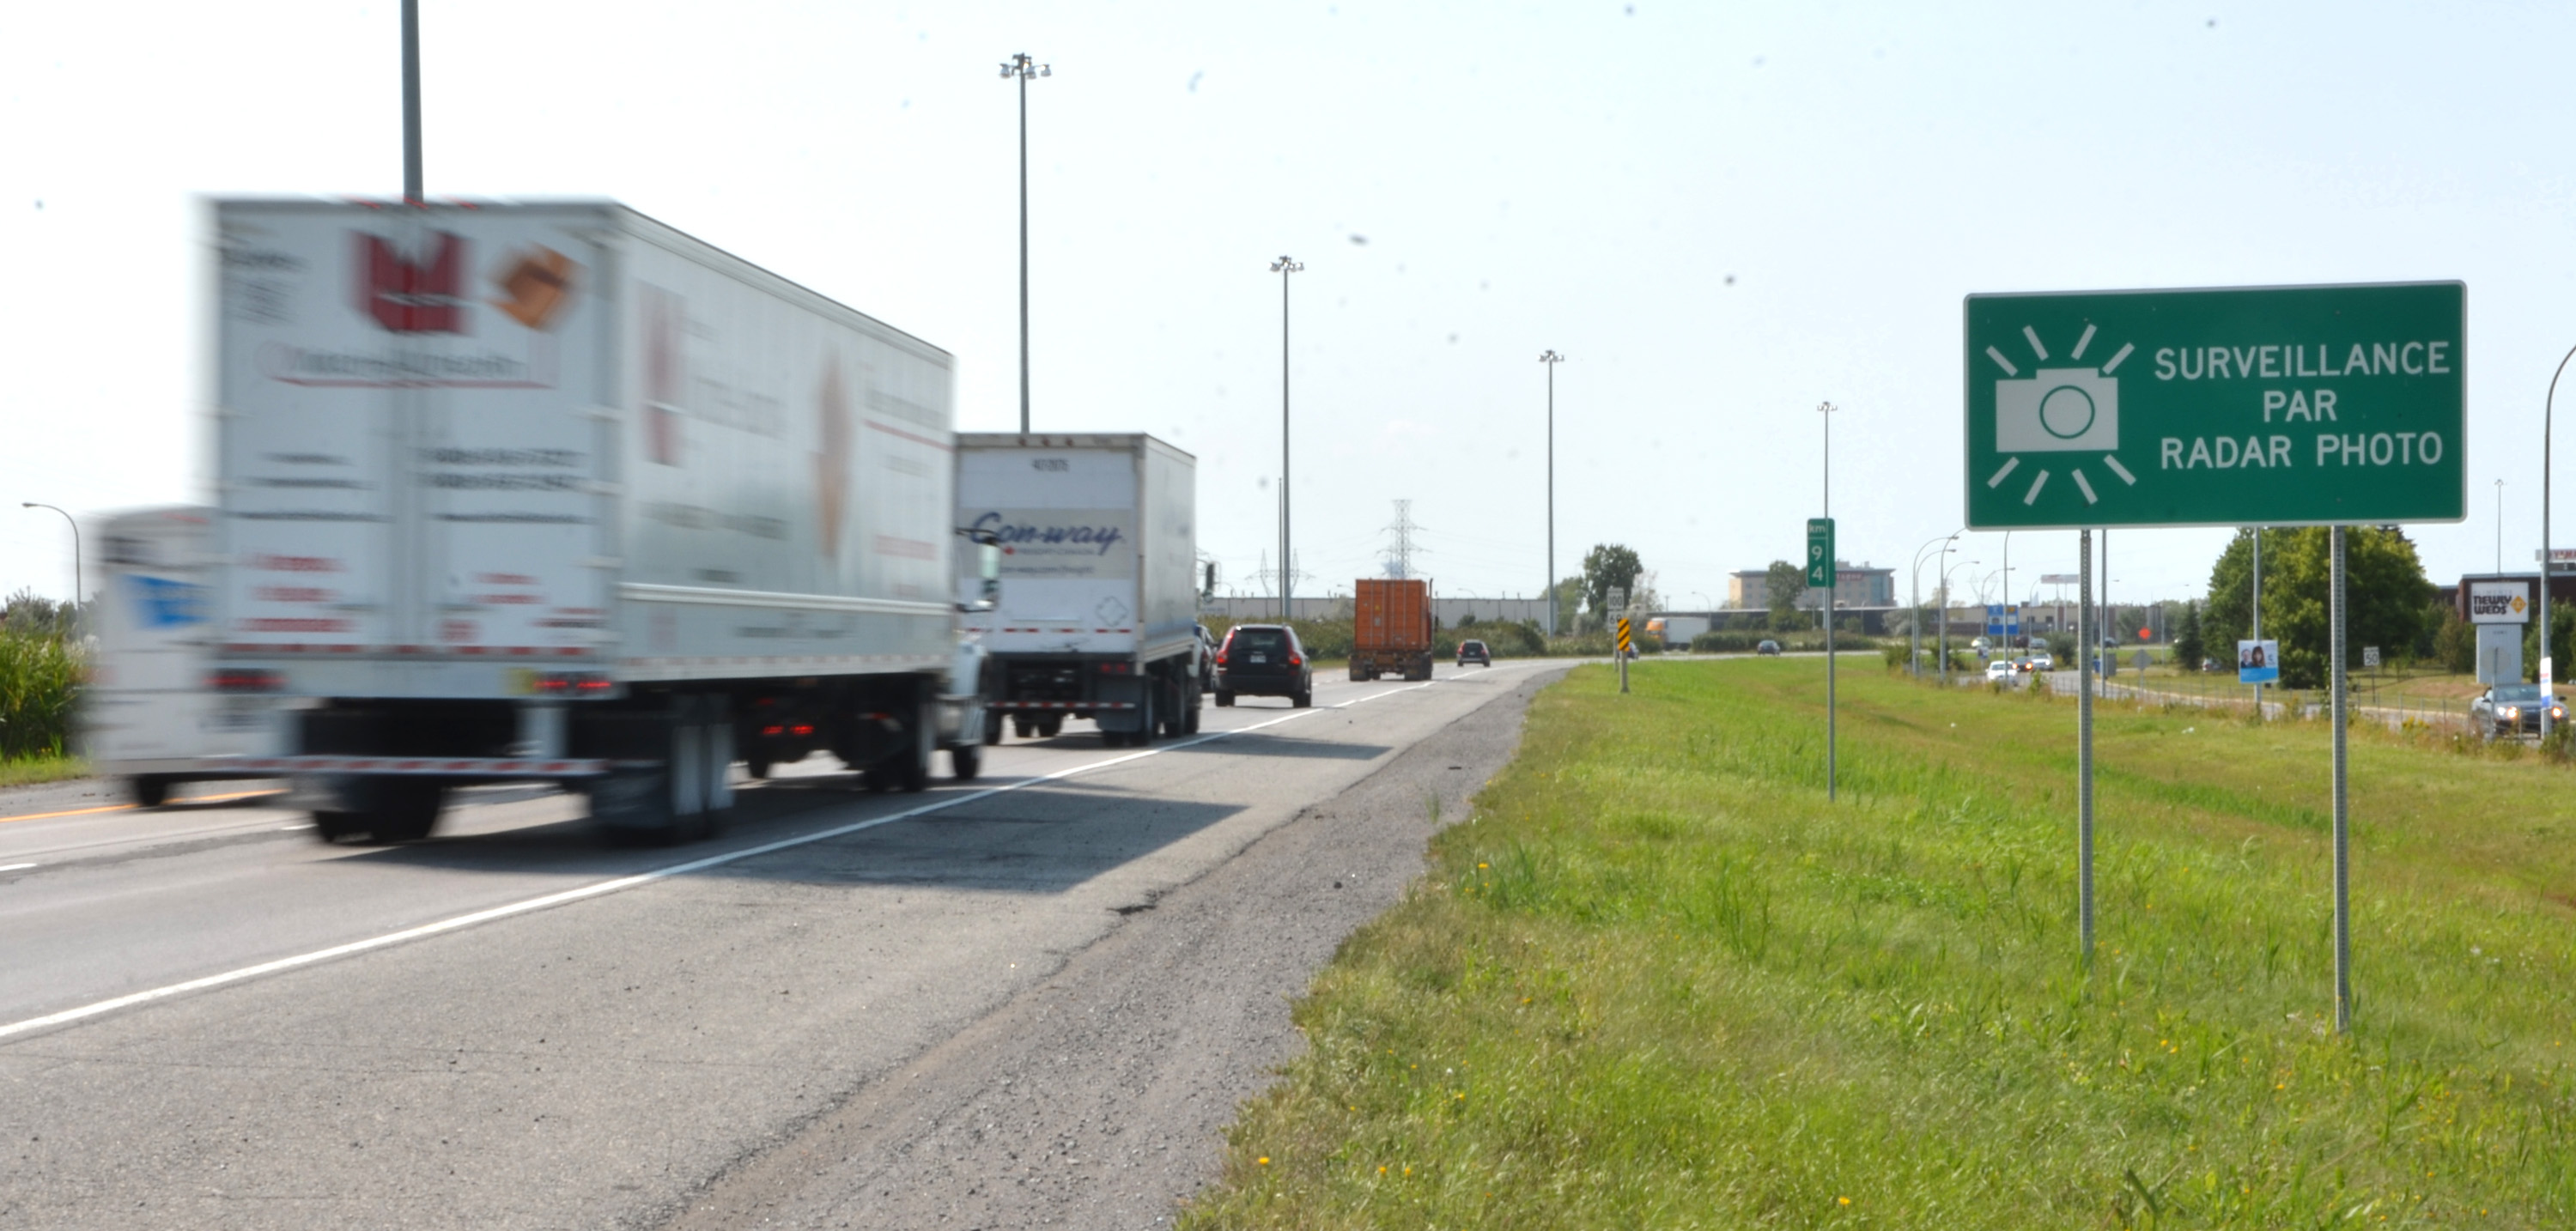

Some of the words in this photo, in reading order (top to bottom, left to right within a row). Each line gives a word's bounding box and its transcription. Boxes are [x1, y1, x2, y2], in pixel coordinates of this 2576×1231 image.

[2154, 342, 2451, 380] SURVEILLANCE
[2263, 389, 2338, 422] PAR
[2160, 435, 2293, 470] RADAR
[2317, 432, 2443, 466] PHOTO
[969, 512, 1123, 557] Con-way
[1808, 524, 1826, 533] km
[1608, 595, 1623, 607] 100
[2473, 605, 2507, 616] WEDS
[2366, 653, 2379, 664] 50
